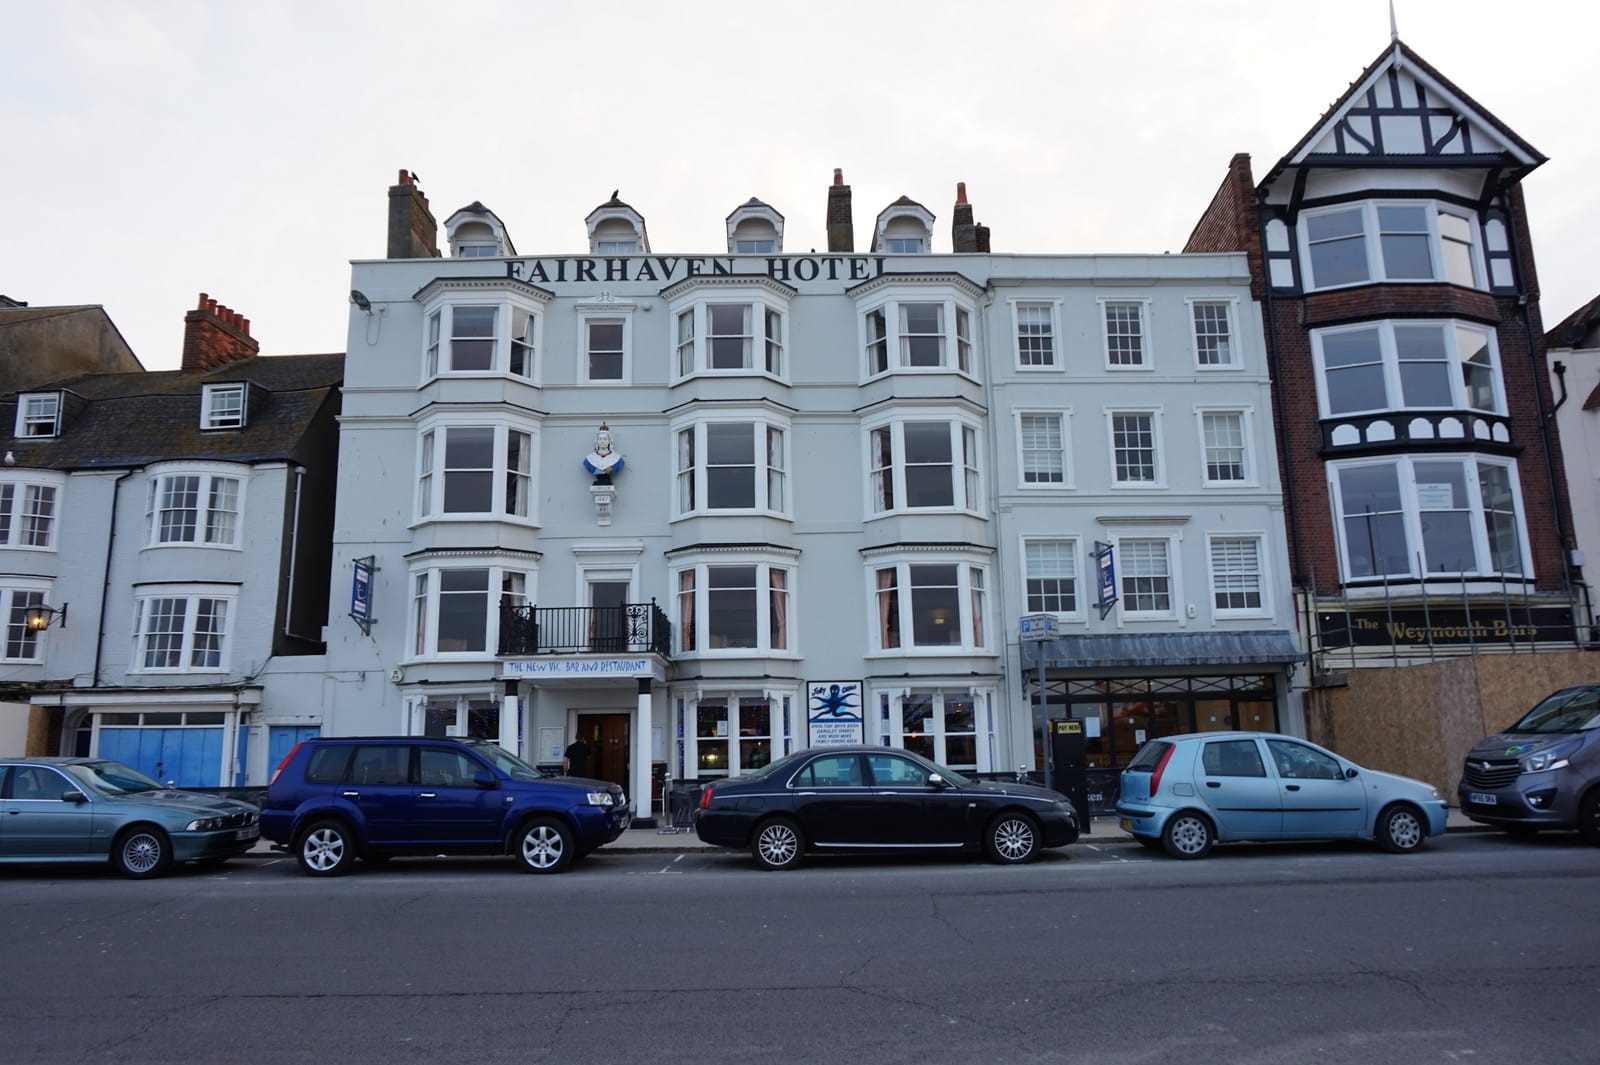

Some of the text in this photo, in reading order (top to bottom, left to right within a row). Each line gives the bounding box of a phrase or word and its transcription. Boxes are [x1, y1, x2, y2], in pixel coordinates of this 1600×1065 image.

[504, 257, 887, 283] FAIRHAVEN HOTEL
[1355, 618, 1380, 630] The
[1492, 619, 1538, 637] Bars
[509, 662, 523, 672] THE
[526, 661, 547, 672] NEW
[566, 661, 580, 672] BAR
[581, 661, 599, 672] AND
[600, 660, 646, 672] RESTAURANT
